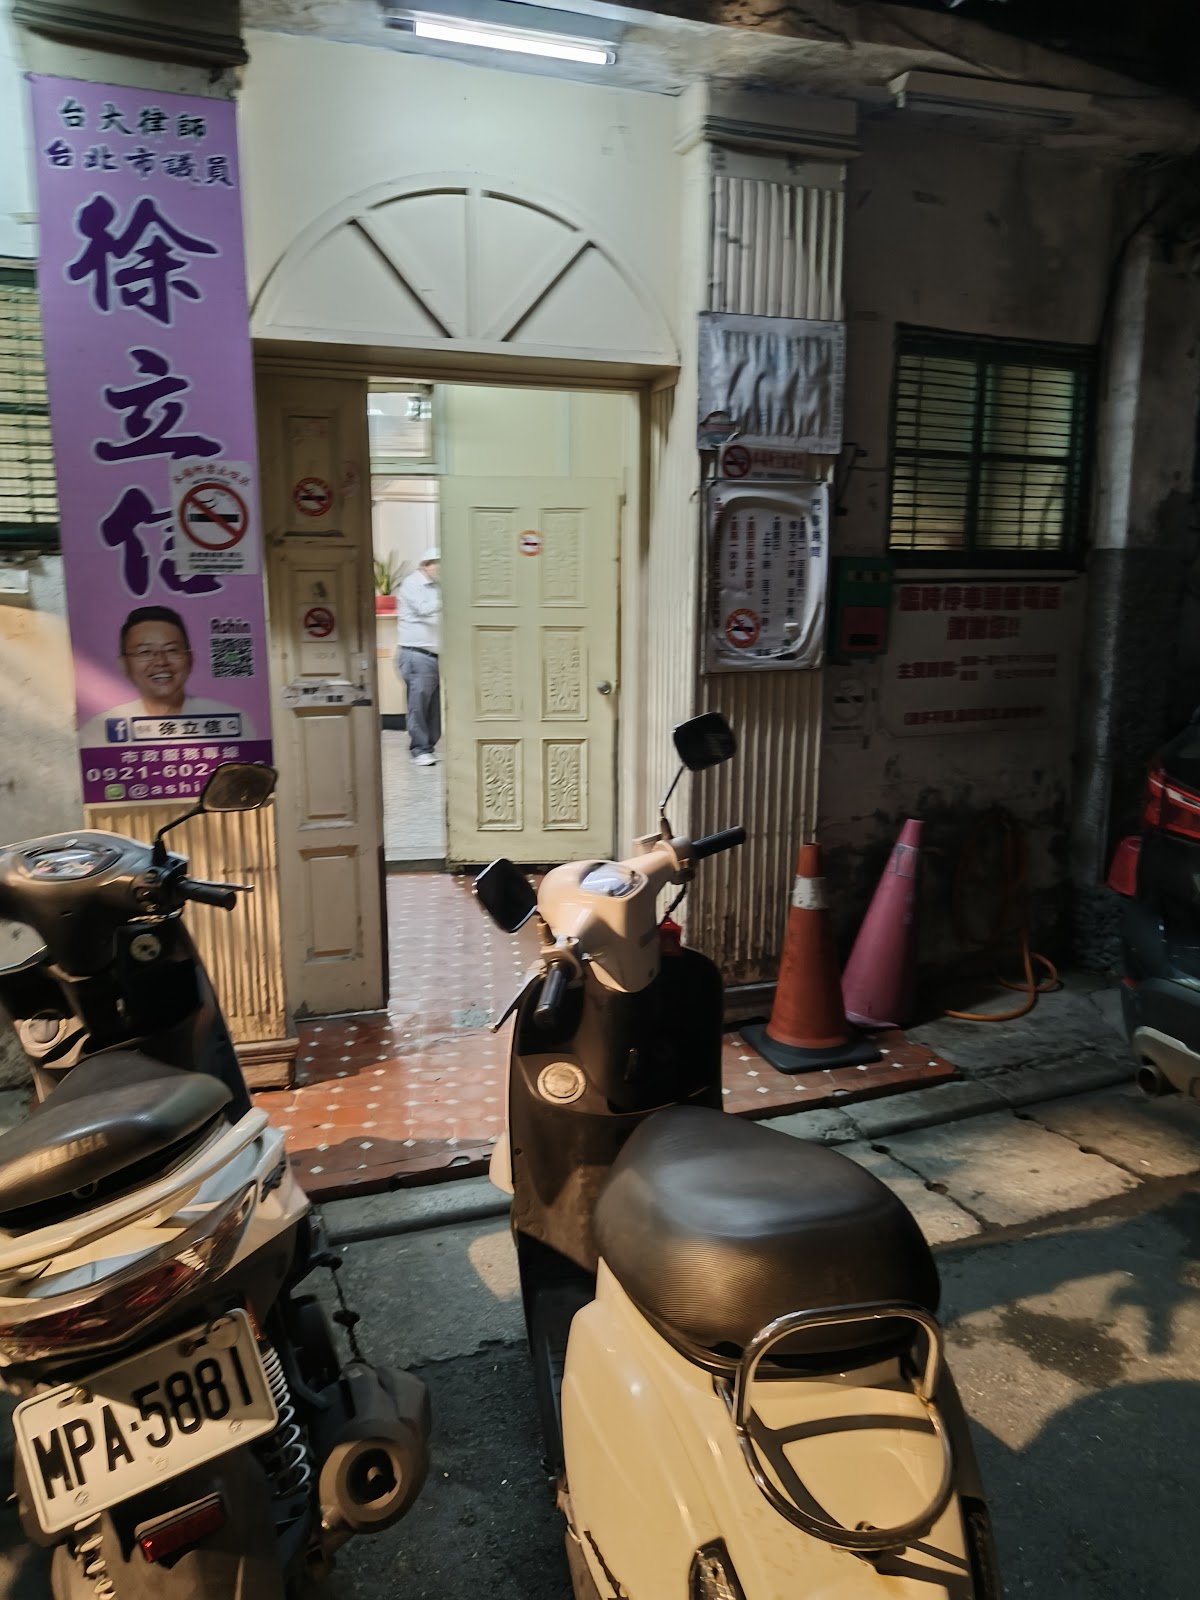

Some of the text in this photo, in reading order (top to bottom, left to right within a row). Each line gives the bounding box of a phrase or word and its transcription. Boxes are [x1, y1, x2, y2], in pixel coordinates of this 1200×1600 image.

[60, 99, 207, 137] 台大律師
[46, 140, 234, 186] 台北市議員
[157, 720, 222, 737] 徐立信
[31, 1346, 253, 1500] MPA-5881
